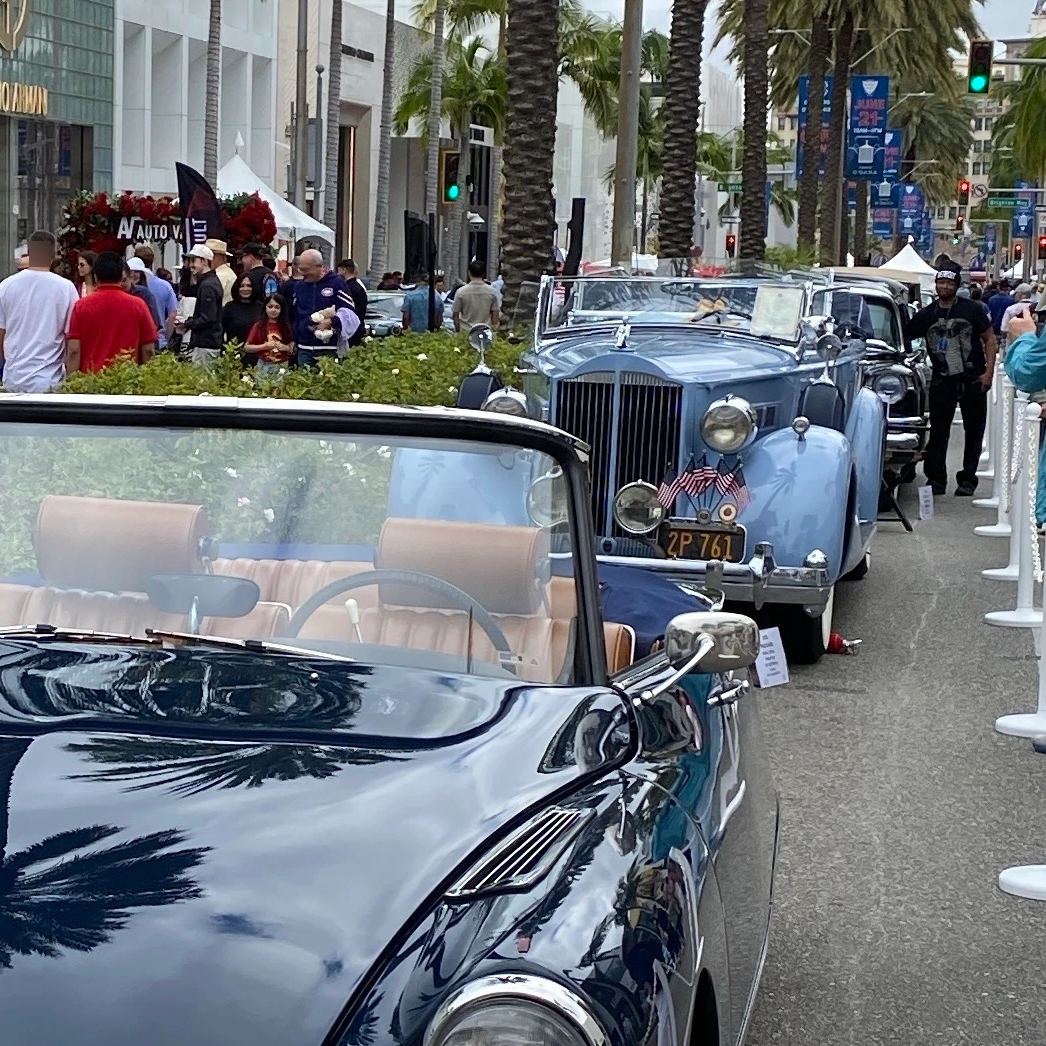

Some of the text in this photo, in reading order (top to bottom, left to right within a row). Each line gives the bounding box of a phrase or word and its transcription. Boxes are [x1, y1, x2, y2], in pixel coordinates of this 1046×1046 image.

[857, 111, 879, 127] 21
[136, 224, 168, 240] AUTO
[192, 217, 207, 243] ULT
[667, 531, 733, 560] 2P 761
